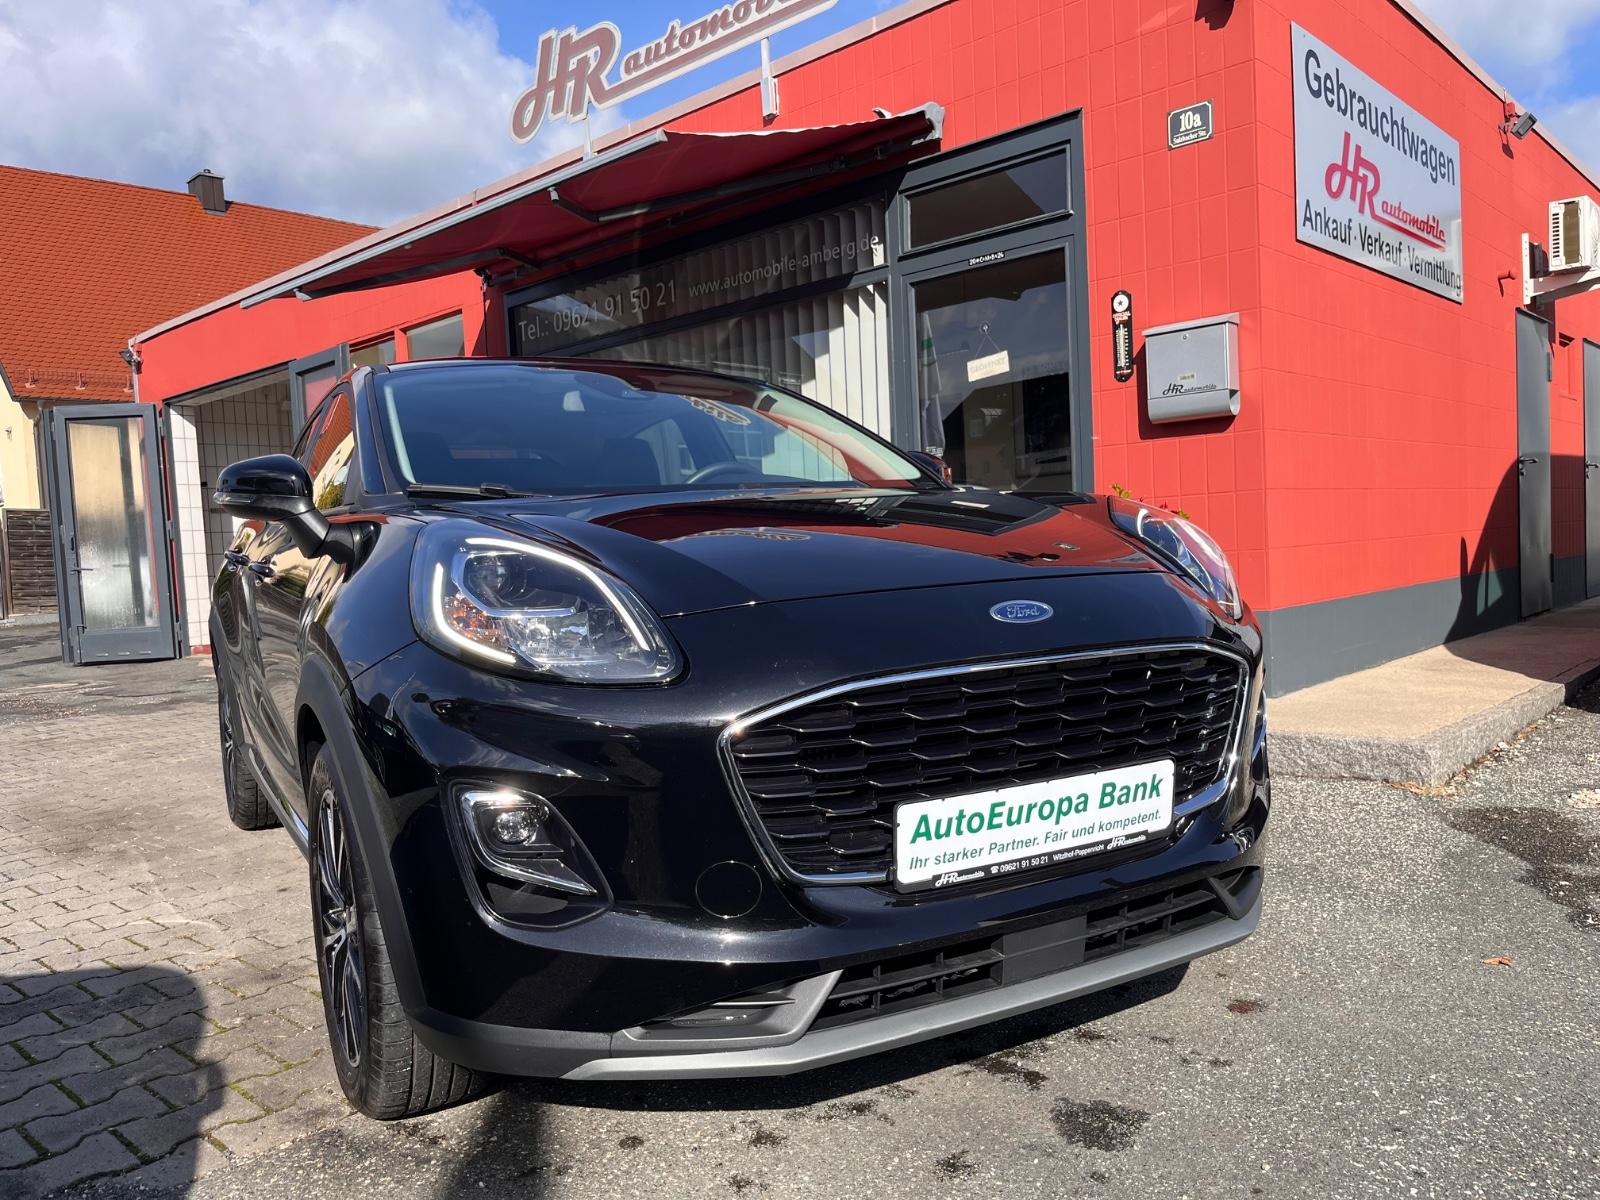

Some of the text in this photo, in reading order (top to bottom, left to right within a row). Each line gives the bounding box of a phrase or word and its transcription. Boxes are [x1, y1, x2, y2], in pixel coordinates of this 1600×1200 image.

[512, 27, 617, 138] HR
[1179, 111, 1203, 132] 10a
[1304, 49, 1456, 186] Gebrauchtwagen
[1324, 131, 1446, 243] HR automobile
[519, 232, 880, 342] Tel.: 09621 91 50 21 www.automobile-amberg.de
[1302, 199, 1463, 297] Ankauf Verkauf Vermittlung
[1006, 604, 1041, 618] Ford
[909, 809, 1161, 871] Ihr starker Partner. Fair und kompetent.
[910, 773, 1164, 844] AutoEuropa Bank
[1000, 863, 1020, 873] 09621
[1021, 859, 1030, 868] 91
[1031, 857, 1040, 866] 50
[1041, 855, 1049, 864] 21
